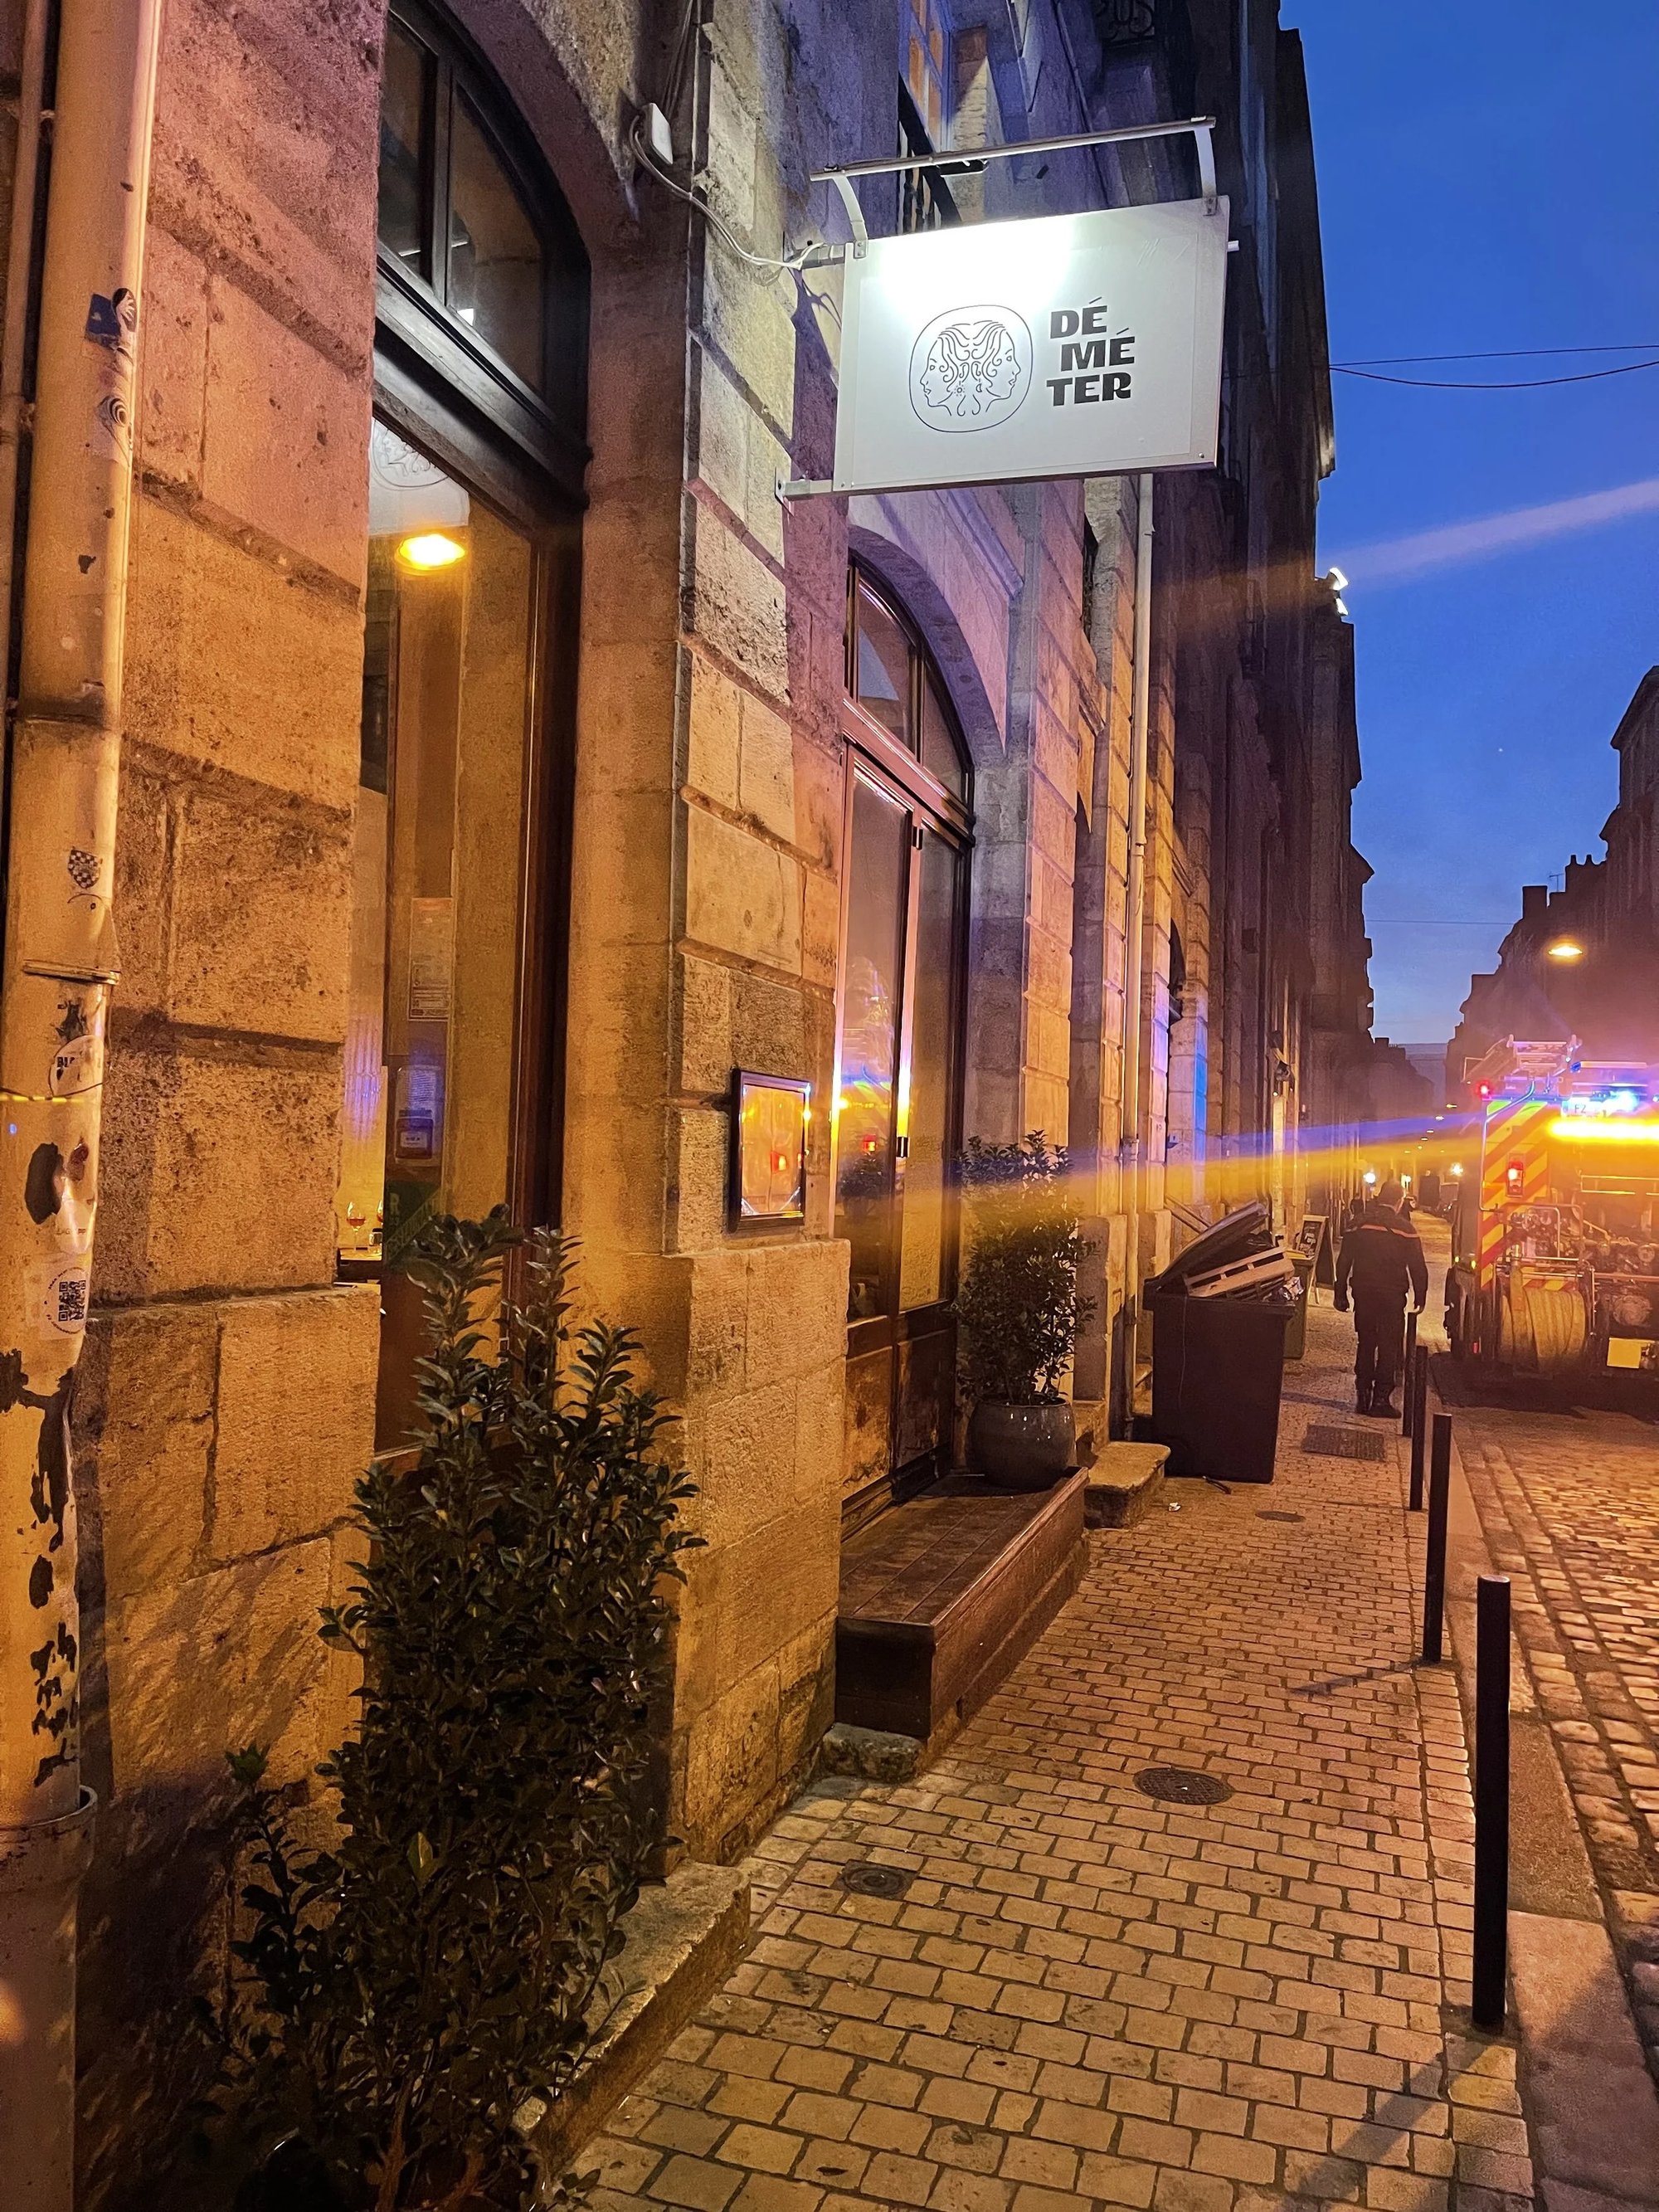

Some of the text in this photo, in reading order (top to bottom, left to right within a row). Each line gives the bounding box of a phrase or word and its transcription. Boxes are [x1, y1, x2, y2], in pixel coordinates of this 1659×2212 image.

[1050, 296, 1107, 339] DÉ
[1061, 327, 1135, 372] MÉ
[1046, 372, 1131, 407] TER
